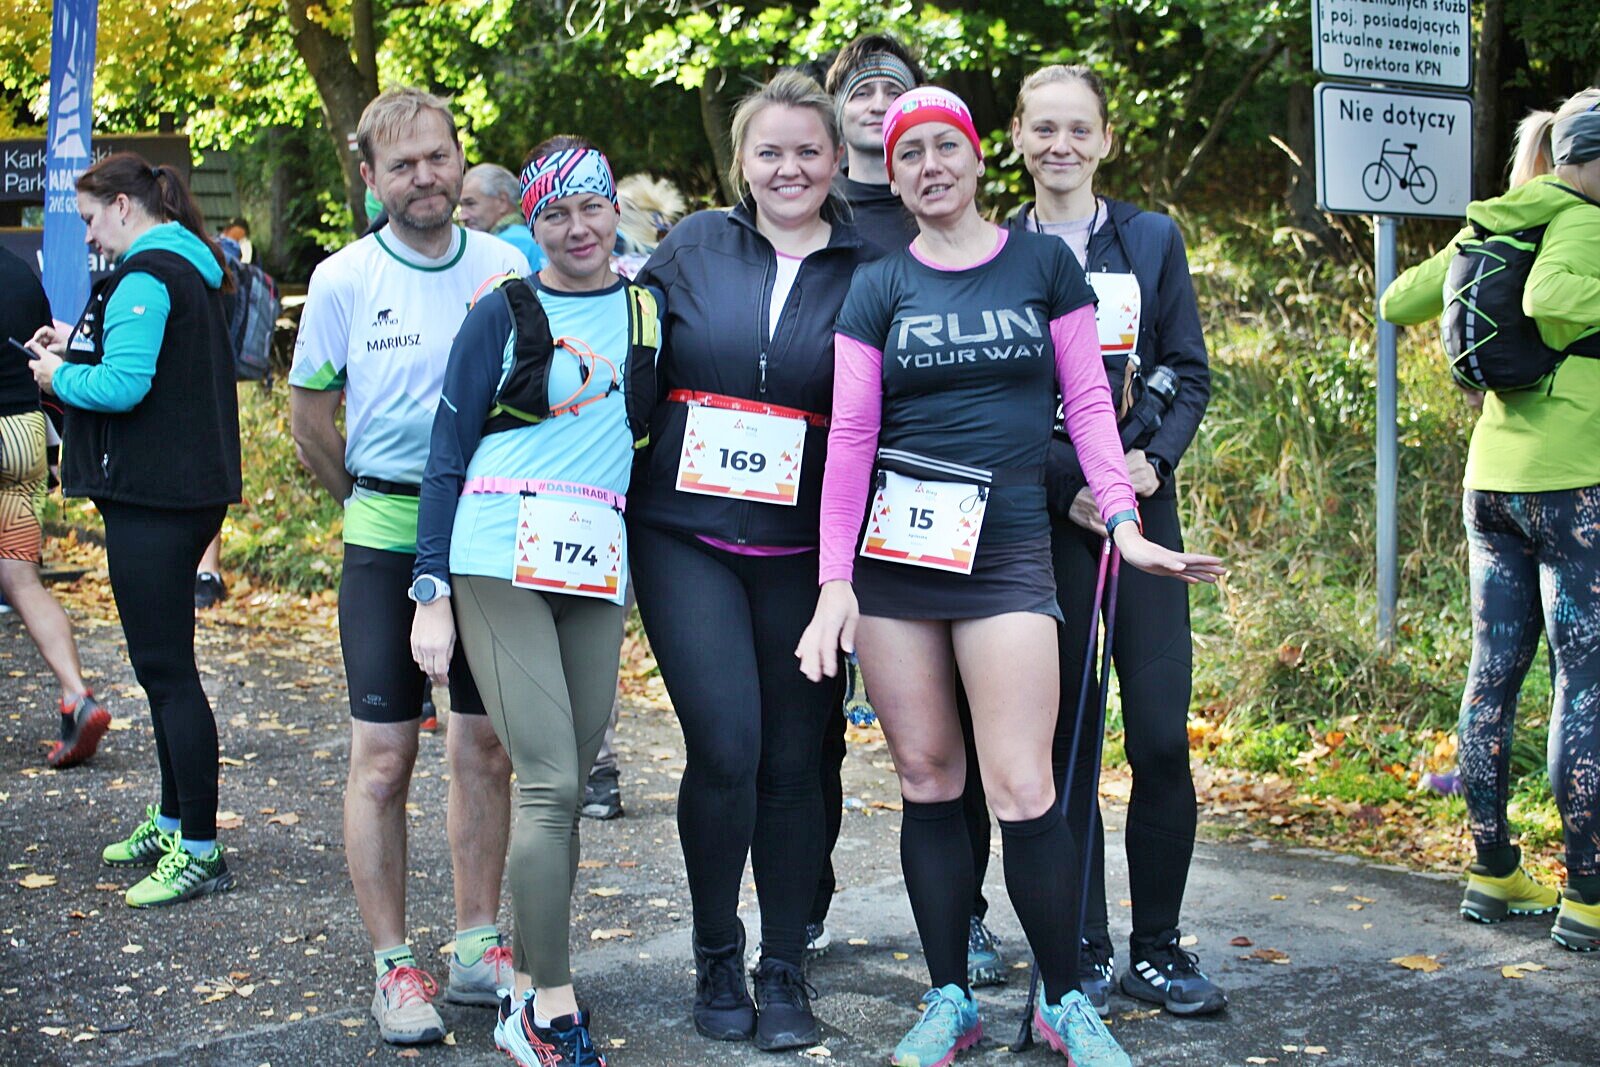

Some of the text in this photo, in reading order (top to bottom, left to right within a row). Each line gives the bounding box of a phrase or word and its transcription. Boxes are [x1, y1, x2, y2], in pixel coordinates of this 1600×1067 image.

[1320, 5, 1325, 20] i
[1331, 8, 1358, 26] poj.
[1363, 12, 1460, 37] posiadających
[1321, 30, 1461, 57] aktualne zezwolenie
[1344, 52, 1442, 77] Dyrektora KPN
[1339, 98, 1456, 136] Nie dotyczy
[897, 306, 1043, 350] RUN
[366, 333, 422, 353] MARIUSZ
[897, 343, 1045, 369] YOUR WAY
[719, 447, 767, 474] 169
[538, 482, 609, 501] #DASHRADE
[909, 506, 934, 530] 15
[553, 540, 598, 567] 174
